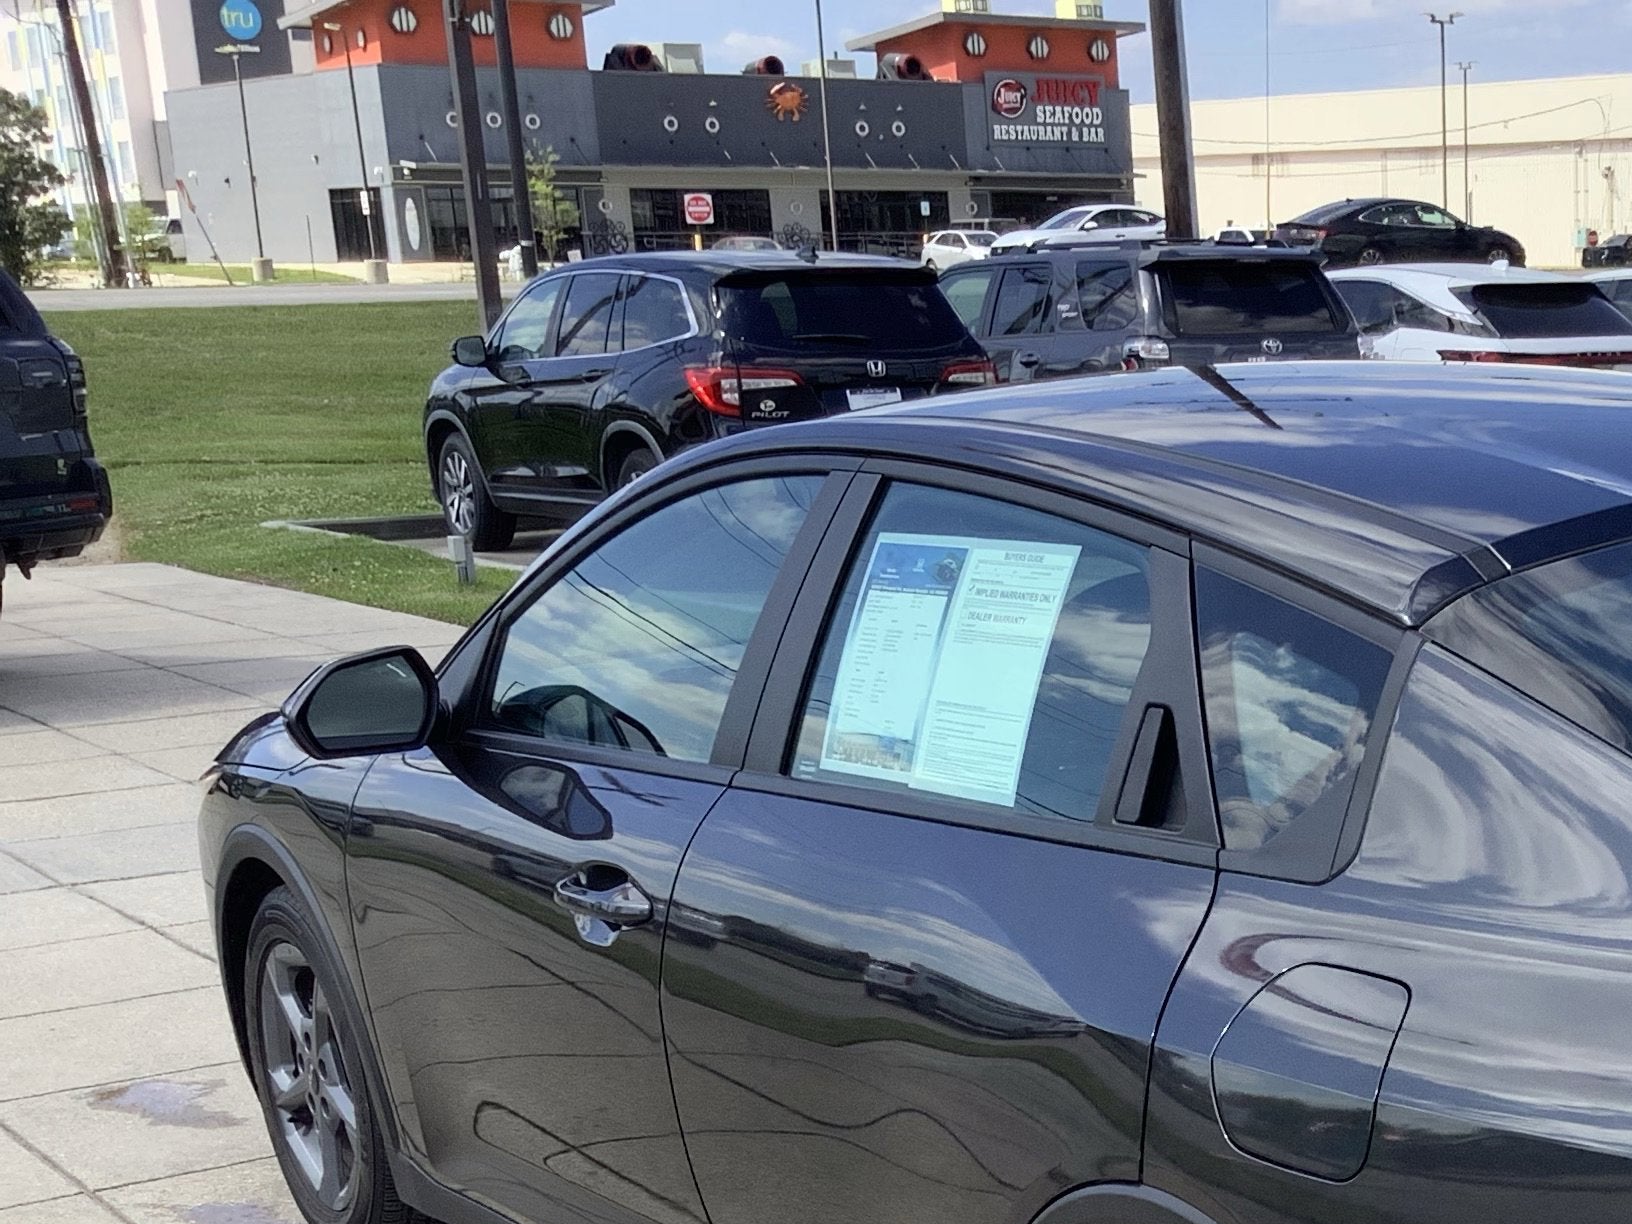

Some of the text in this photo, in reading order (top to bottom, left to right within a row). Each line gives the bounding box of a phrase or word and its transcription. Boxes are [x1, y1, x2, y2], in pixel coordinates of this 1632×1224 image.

[223, 5, 254, 28] tru
[1031, 79, 1099, 106] JUICY
[1036, 105, 1103, 125] SEAFOOD
[993, 124, 1105, 143] RESTAURANT & BAR
[751, 410, 790, 418] PILOT
